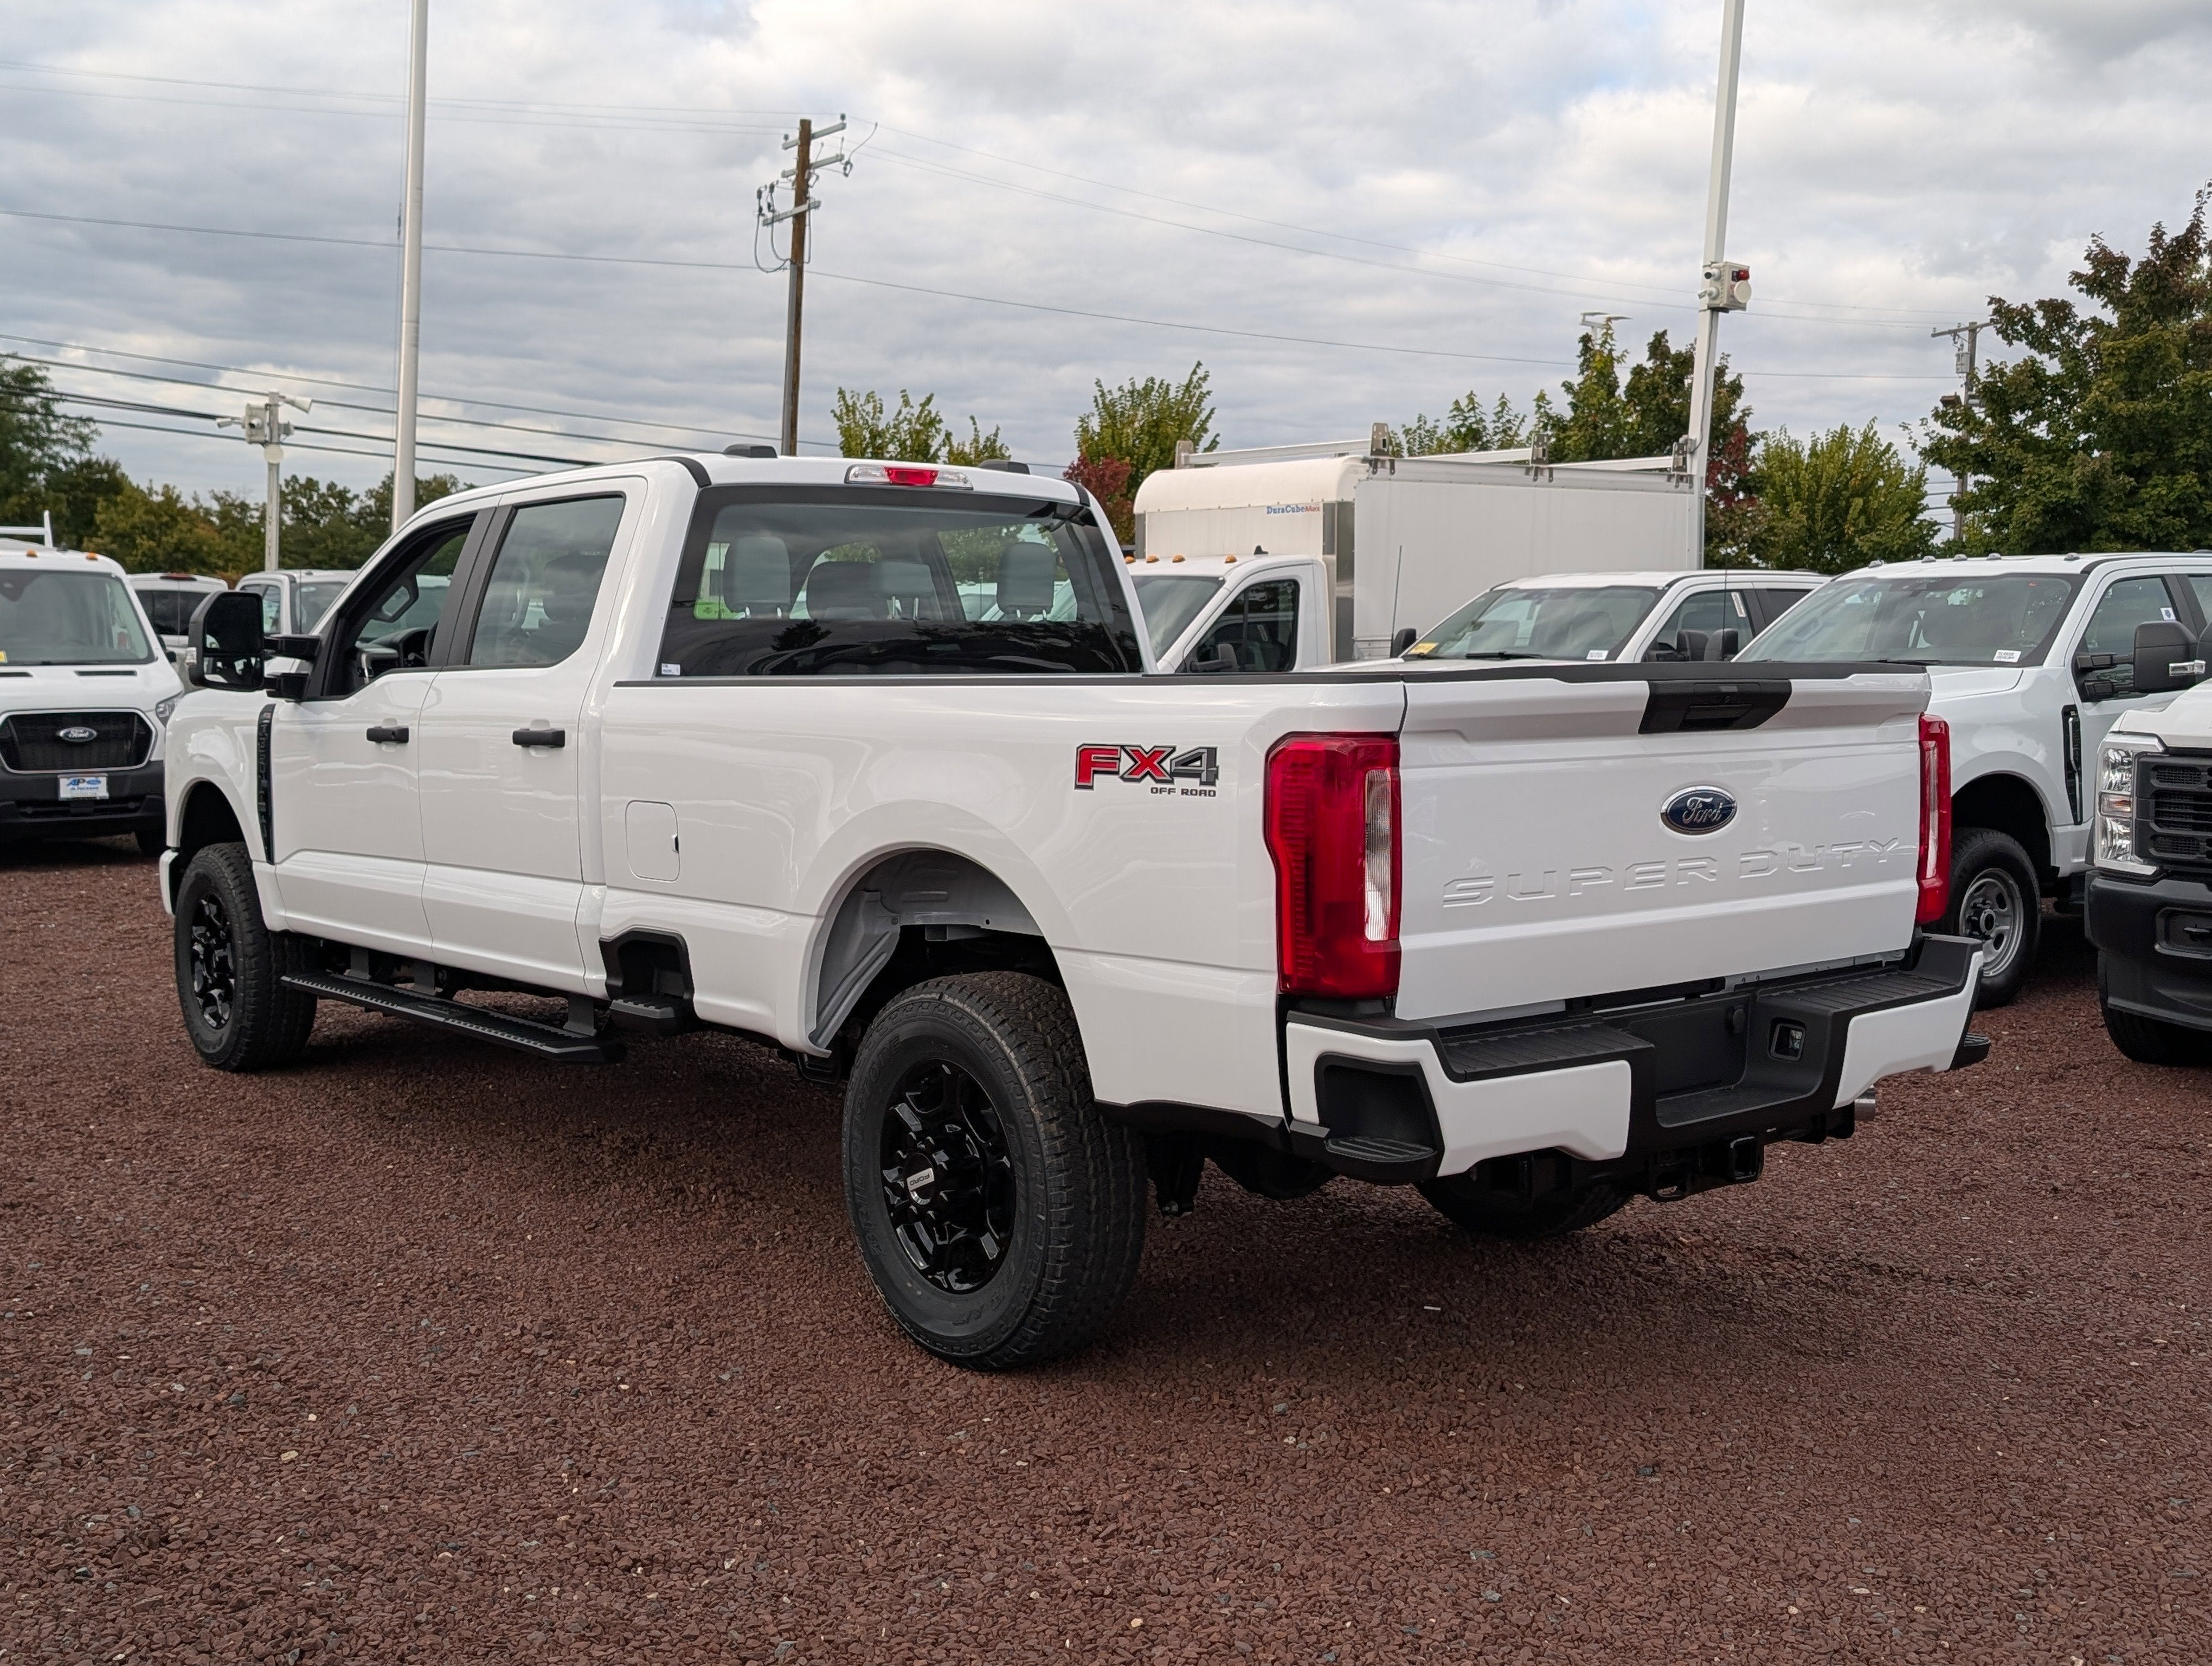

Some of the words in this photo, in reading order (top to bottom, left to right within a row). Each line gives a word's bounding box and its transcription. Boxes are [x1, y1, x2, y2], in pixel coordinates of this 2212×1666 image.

[1074, 743, 1220, 790] FX4
[1150, 787, 1176, 795] OFF
[1181, 789, 1217, 797] ROAD
[1682, 796, 1723, 824] Ford
[1442, 855, 1718, 908] SUPER
[1739, 837, 1899, 879] DUTY
[909, 1173, 930, 1186] FORD
